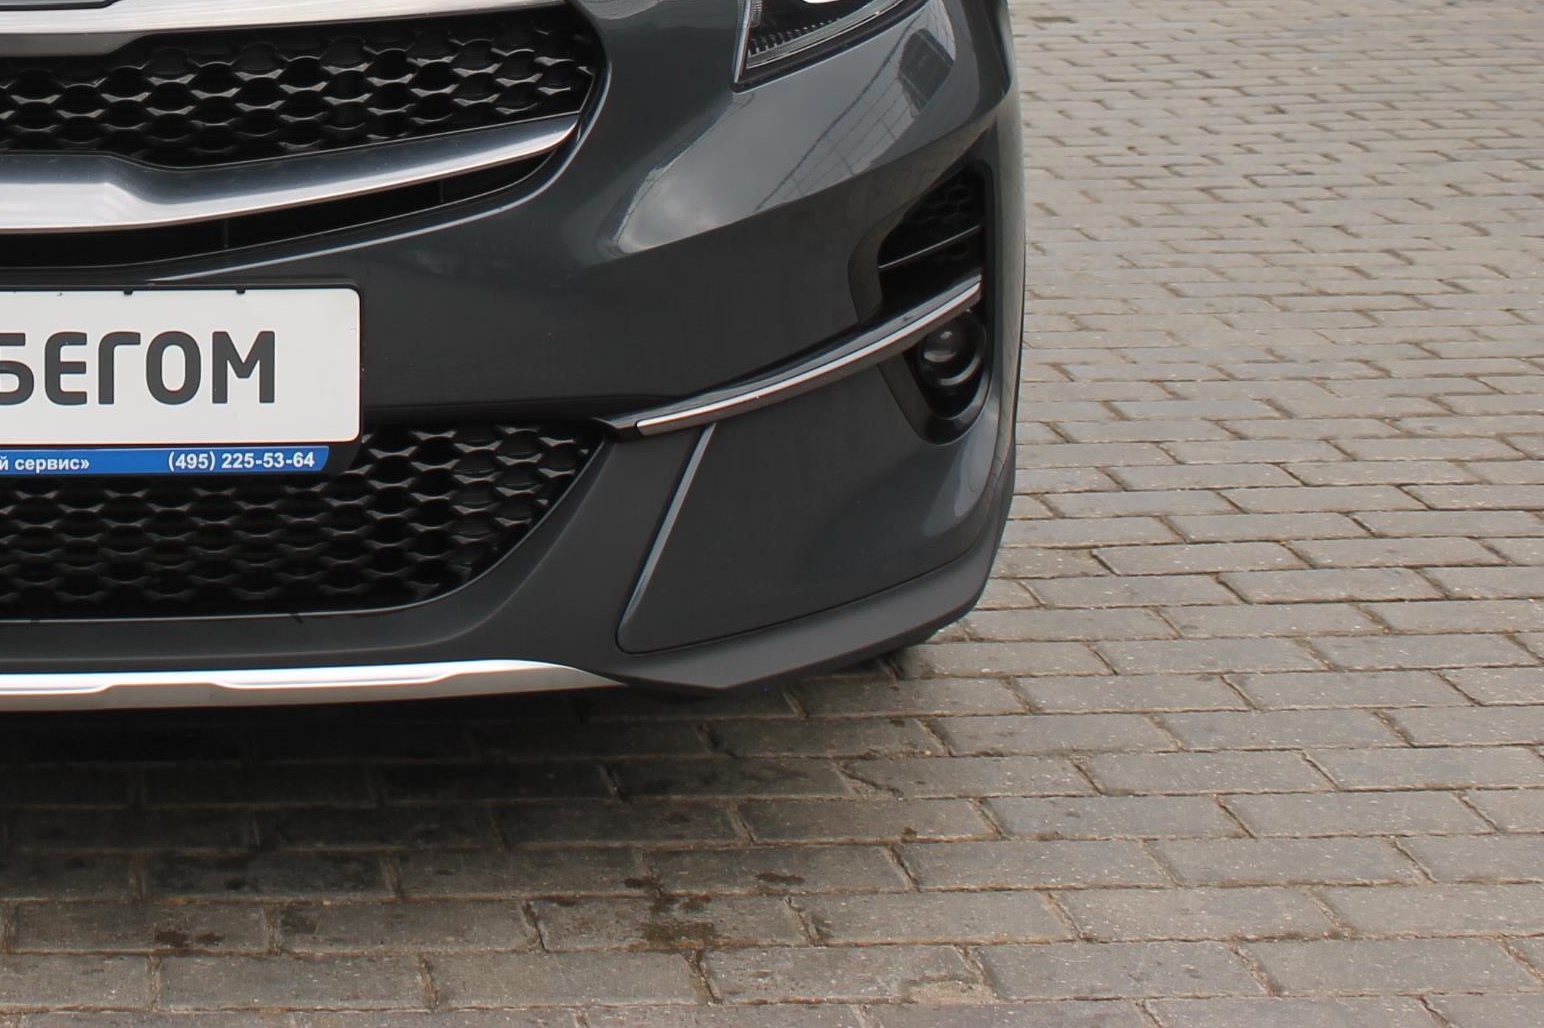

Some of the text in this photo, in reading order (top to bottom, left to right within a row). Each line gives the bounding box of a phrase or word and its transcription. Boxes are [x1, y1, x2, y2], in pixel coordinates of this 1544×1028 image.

[14, 456, 90, 473] сервис»
[168, 451, 315, 471] (495) 225-53-64
